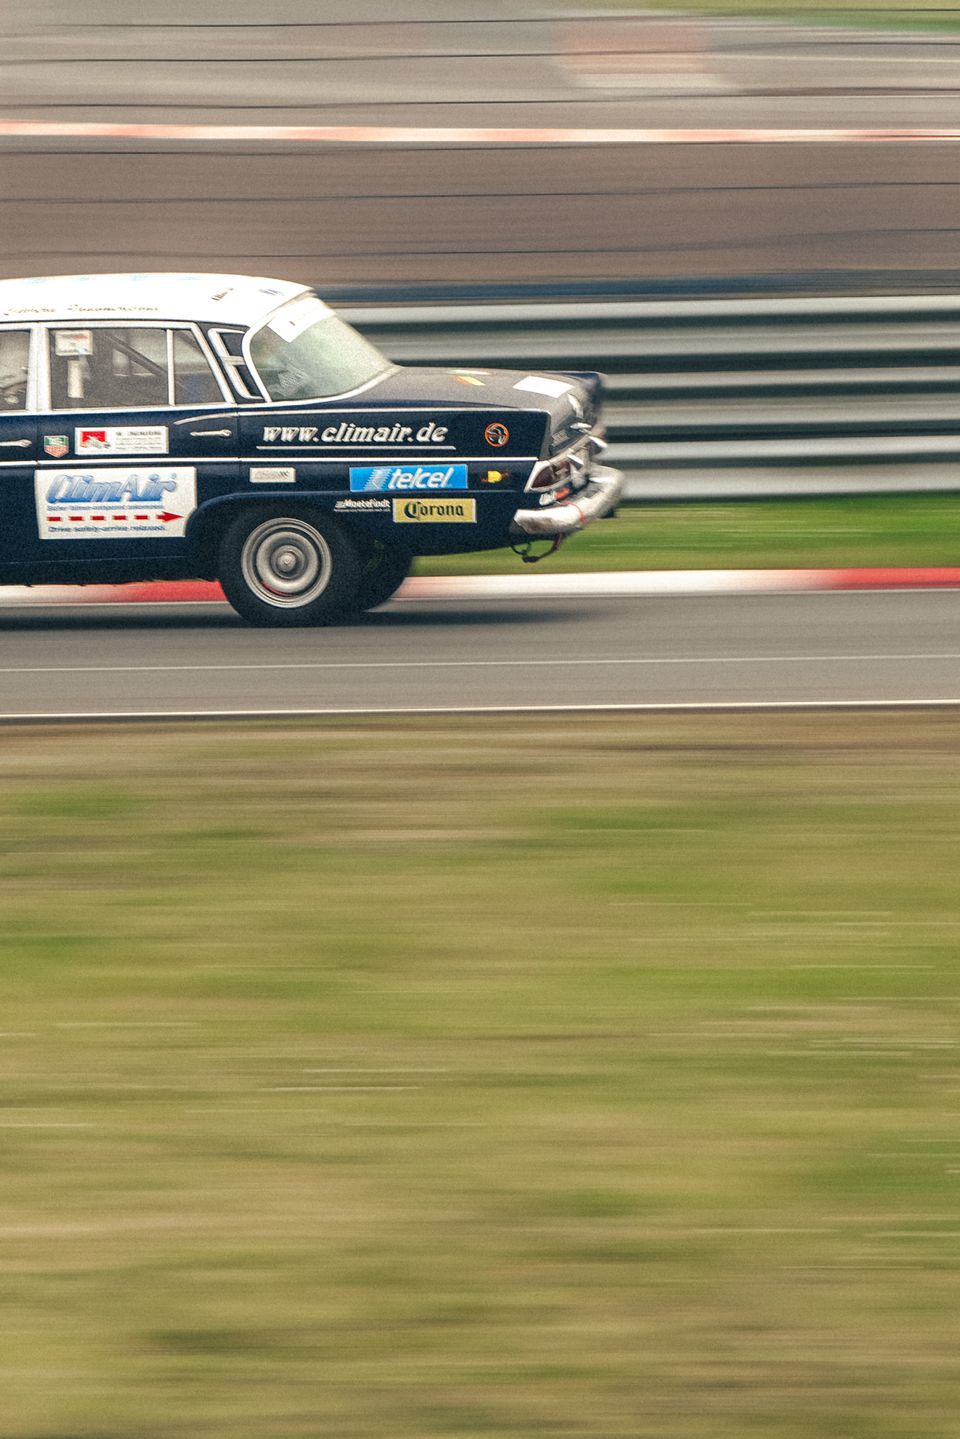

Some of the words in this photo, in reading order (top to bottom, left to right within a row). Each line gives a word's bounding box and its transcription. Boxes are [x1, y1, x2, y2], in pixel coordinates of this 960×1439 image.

[263, 422, 449, 443] www.climair.de
[388, 467, 454, 490] telcel
[404, 501, 465, 520] Corona
